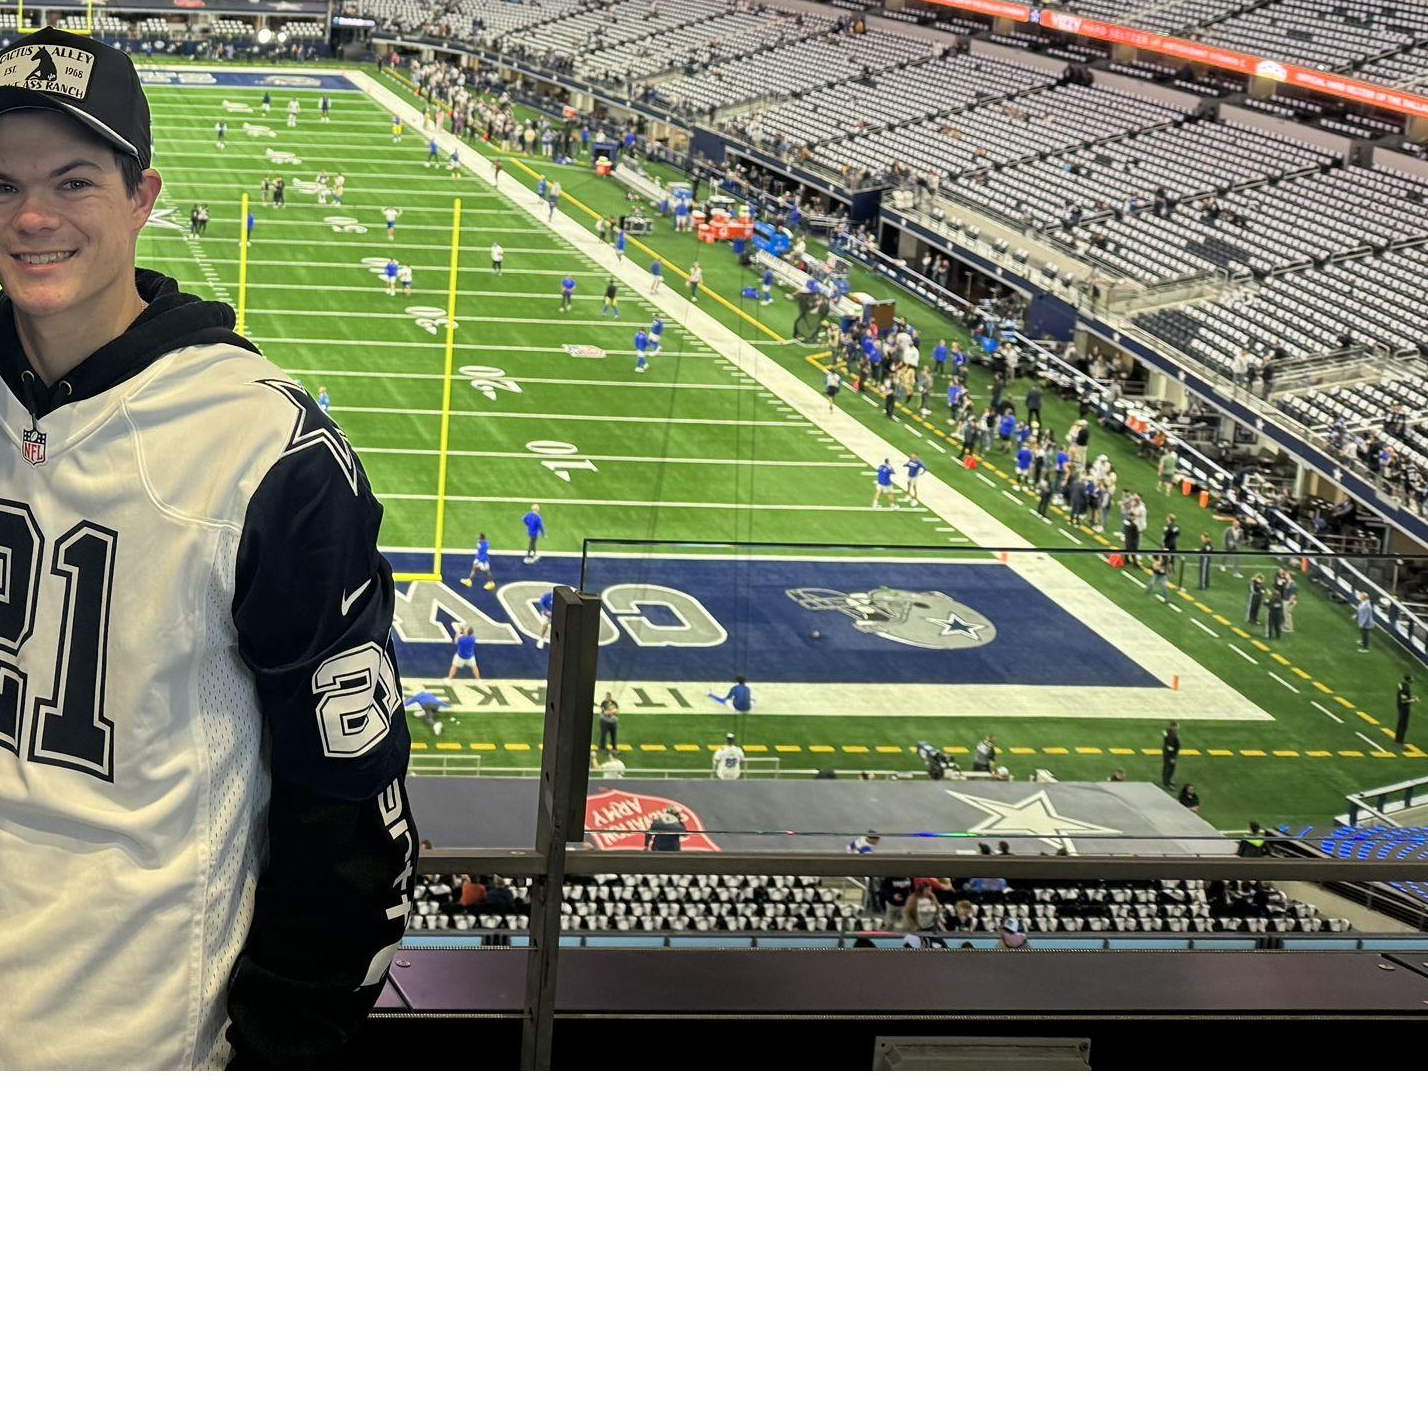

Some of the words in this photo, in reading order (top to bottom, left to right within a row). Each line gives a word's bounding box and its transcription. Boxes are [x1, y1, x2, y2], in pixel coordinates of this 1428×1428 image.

[0, 46, 34, 65] CACTUS
[65, 66, 84, 79] 1968
[45, 81, 84, 99] RANCH
[22, 441, 46, 464] NFL
[591, 796, 644, 828] ARMY
